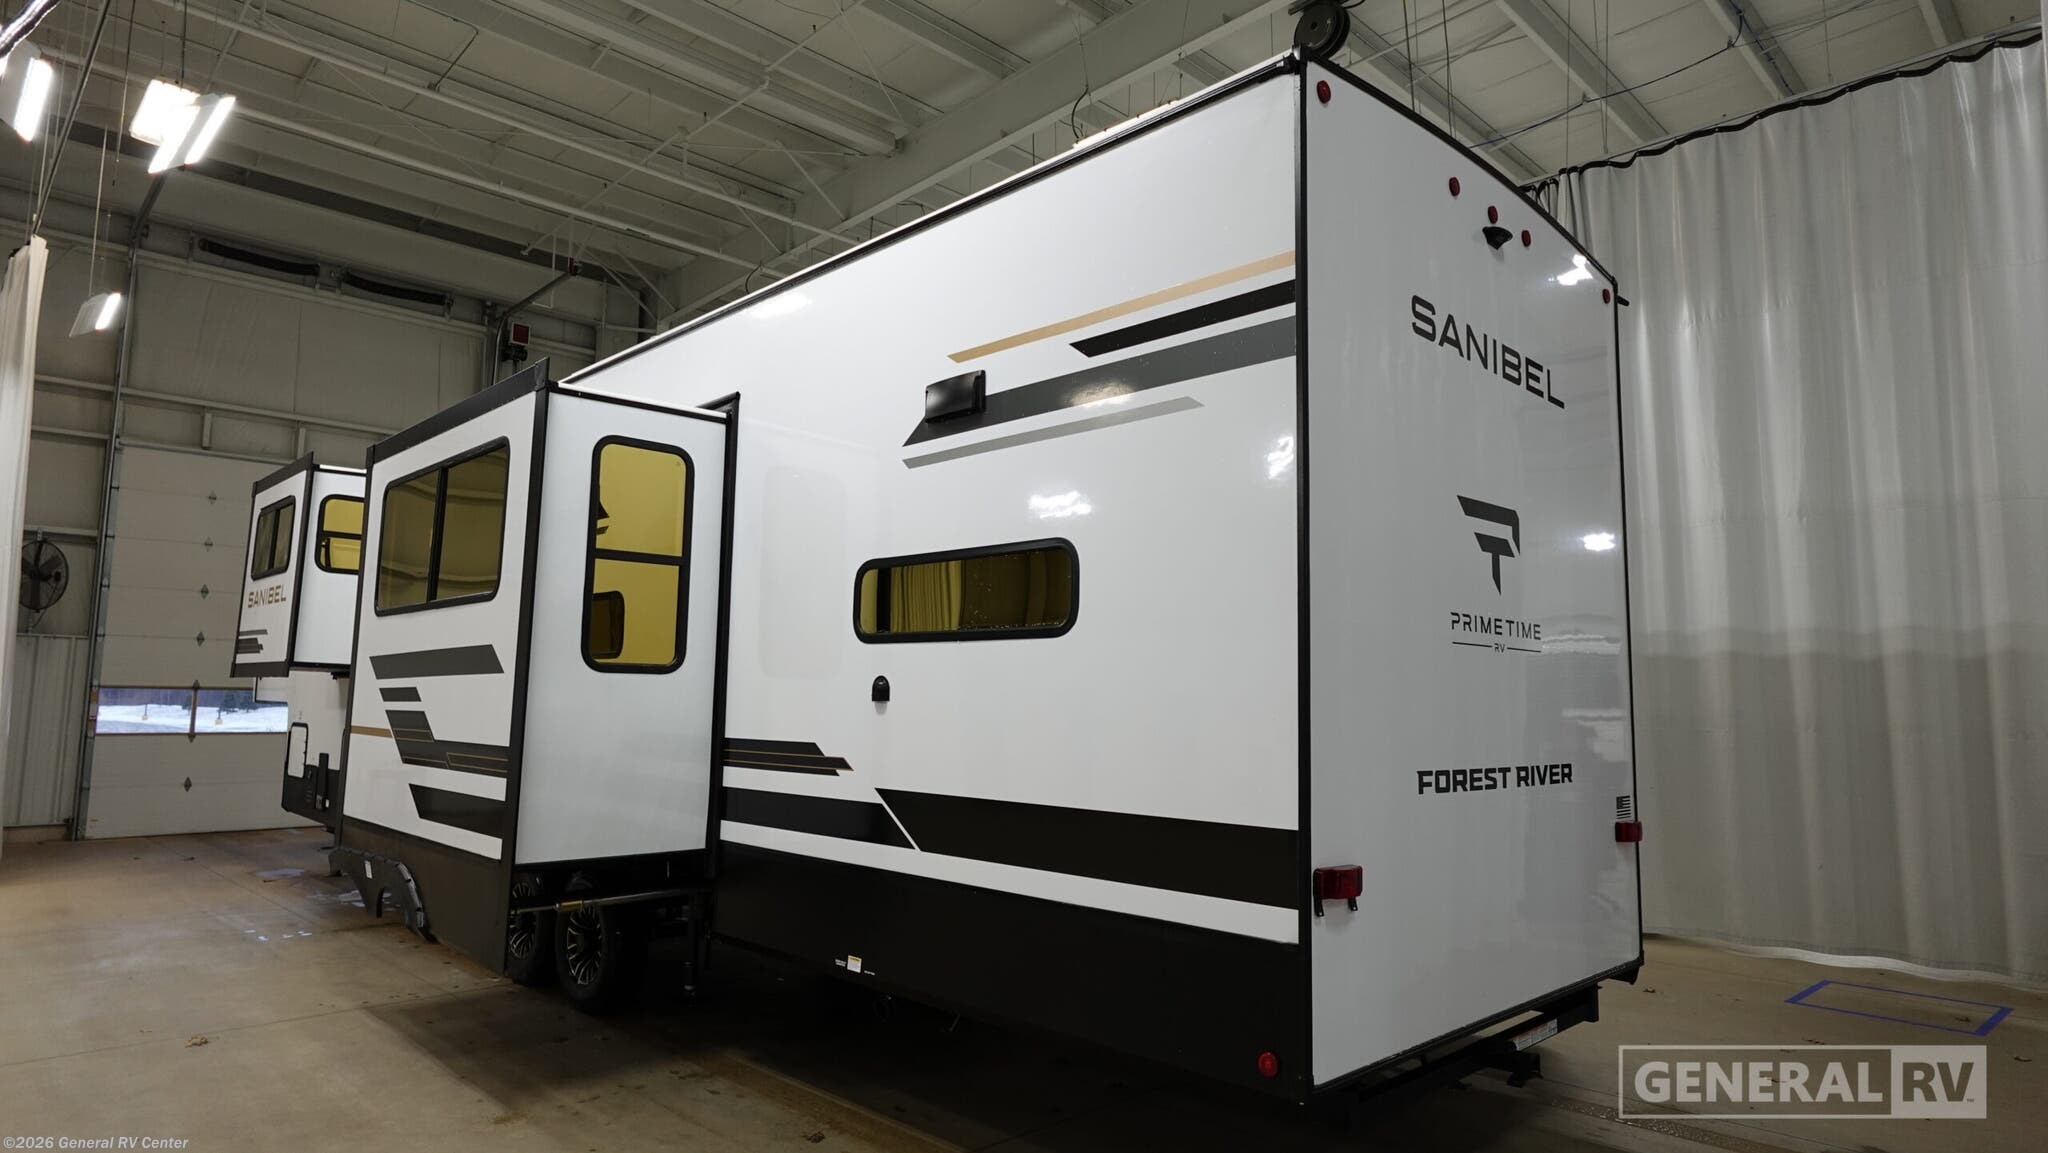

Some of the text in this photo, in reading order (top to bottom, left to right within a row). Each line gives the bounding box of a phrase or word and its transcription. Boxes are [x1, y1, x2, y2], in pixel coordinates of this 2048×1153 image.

[1411, 294, 1565, 409] SANIBEL
[247, 585, 287, 609] SANIBEL
[1494, 643, 1505, 653] RV
[1416, 763, 1573, 795] FOREST RIVER
